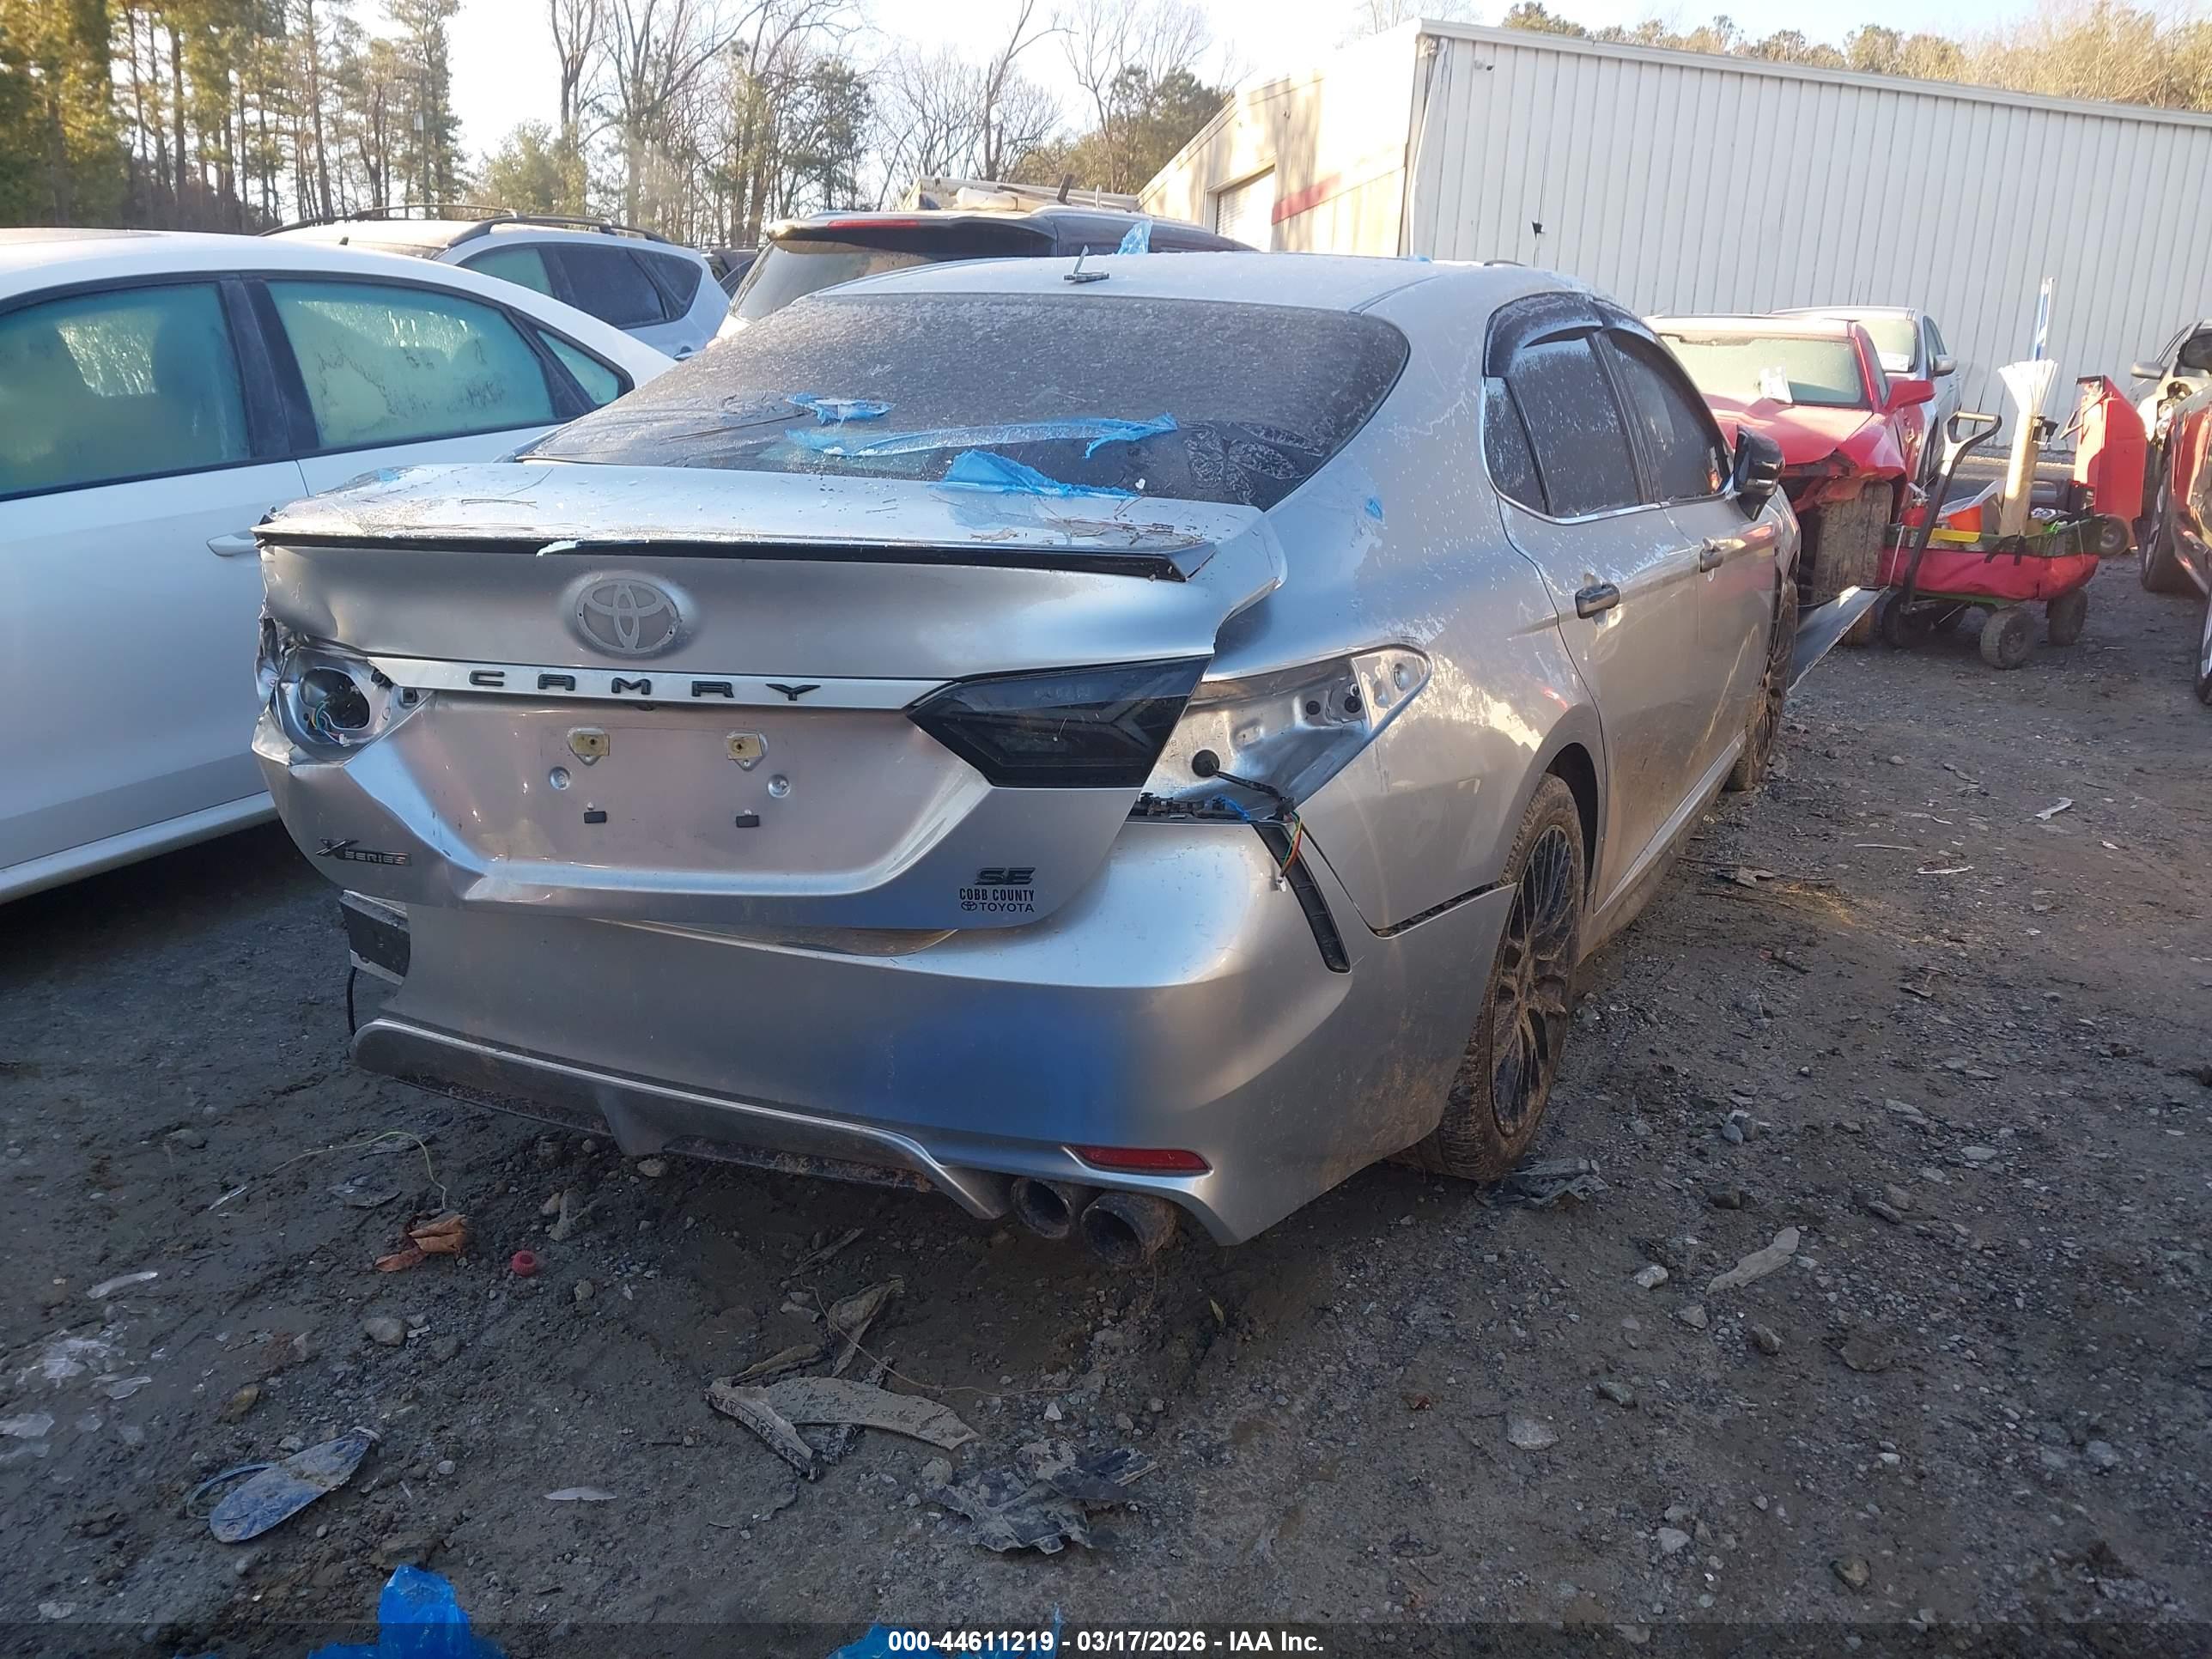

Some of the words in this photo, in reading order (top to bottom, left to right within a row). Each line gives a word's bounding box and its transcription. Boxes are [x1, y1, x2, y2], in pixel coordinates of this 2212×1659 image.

[468, 669, 822, 702] CAMRY
[343, 849, 407, 866] SERIES
[975, 866, 1036, 885] SE
[959, 888, 988, 901] COBB
[992, 888, 1035, 902] COUNTY
[979, 902, 1035, 913] TOYOTA
